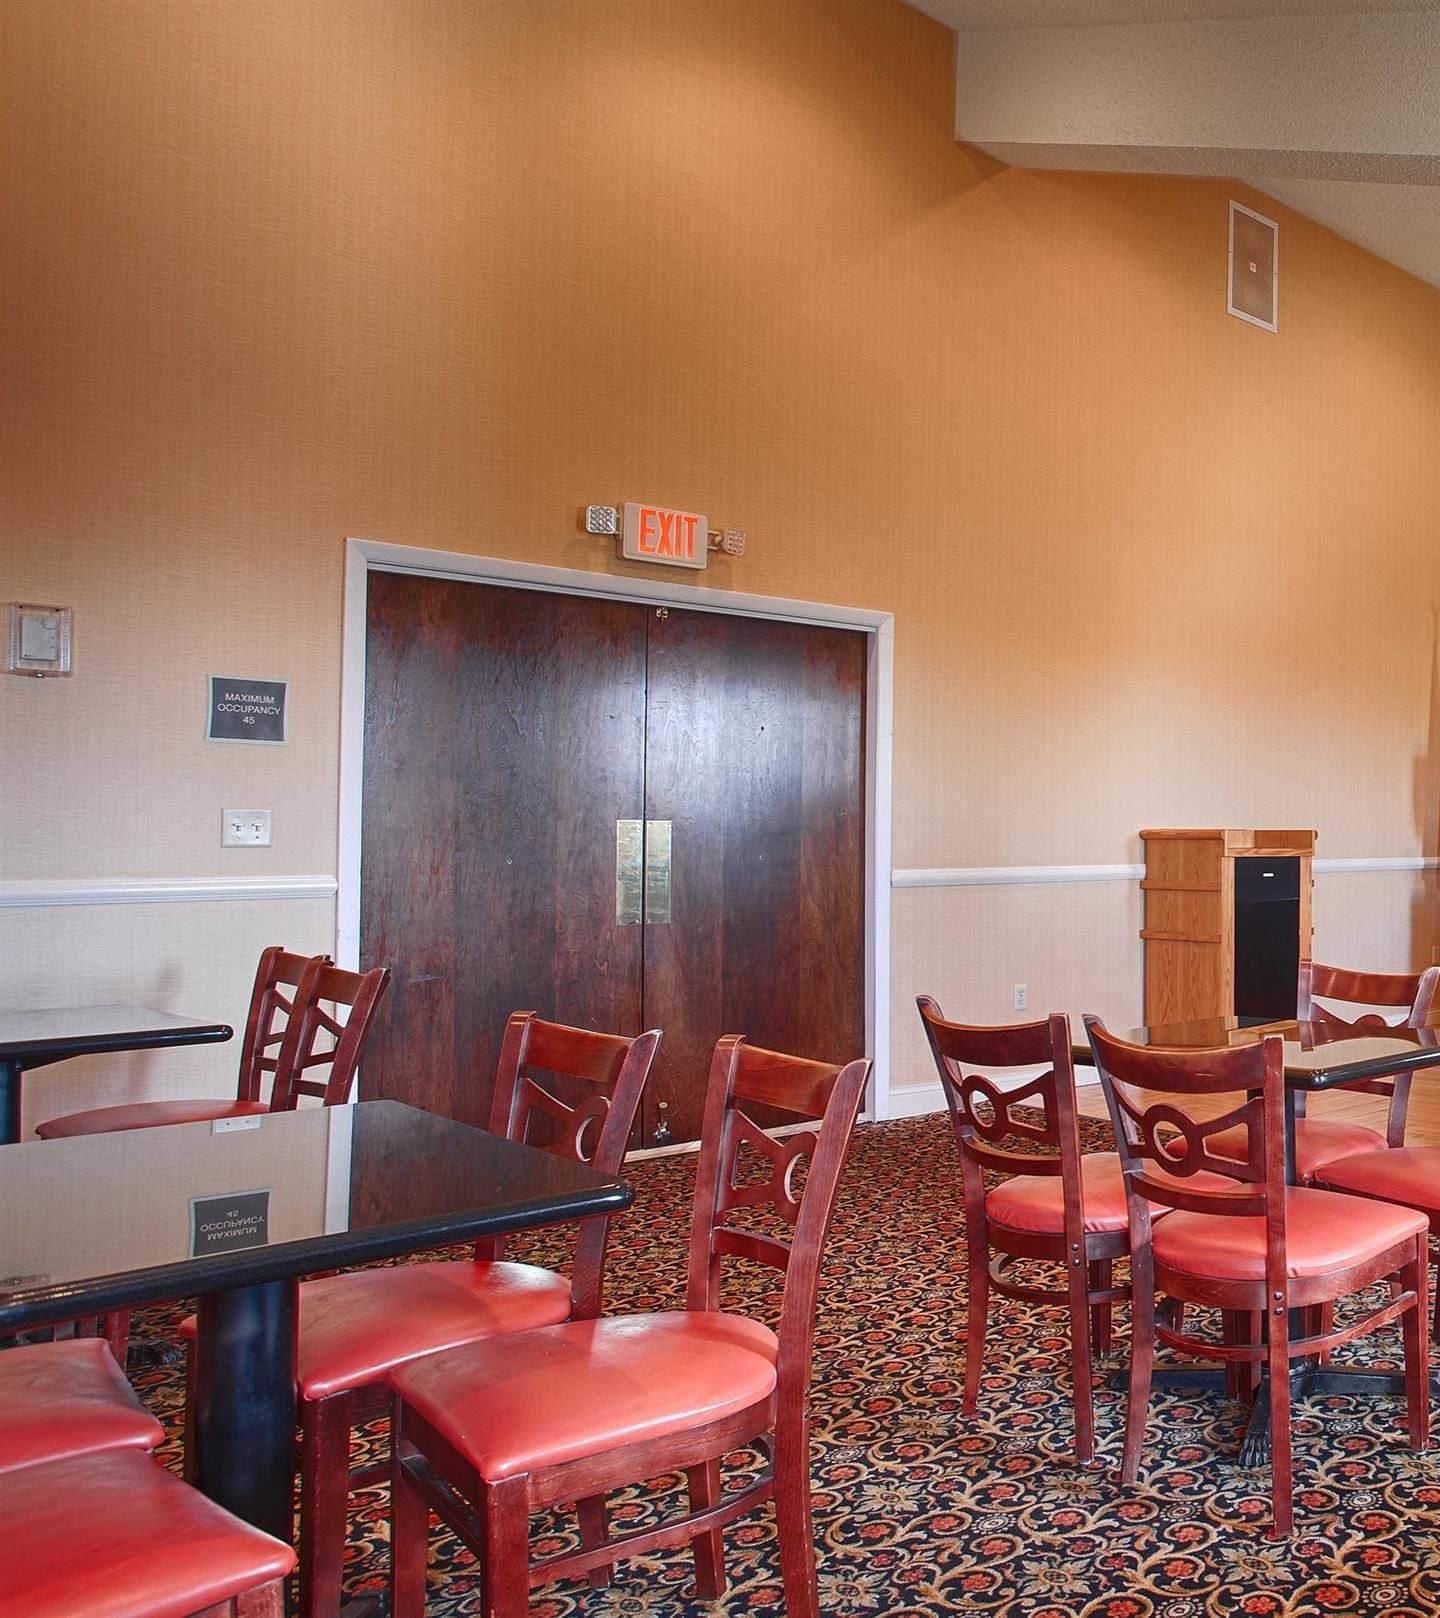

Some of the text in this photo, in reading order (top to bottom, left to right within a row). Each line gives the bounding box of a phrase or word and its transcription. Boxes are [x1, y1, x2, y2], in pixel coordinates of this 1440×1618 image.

[638, 507, 699, 560] EXIT
[225, 693, 275, 704] MAXIMUM
[217, 703, 281, 715] OCCUPANCY
[242, 716, 256, 725] 45
